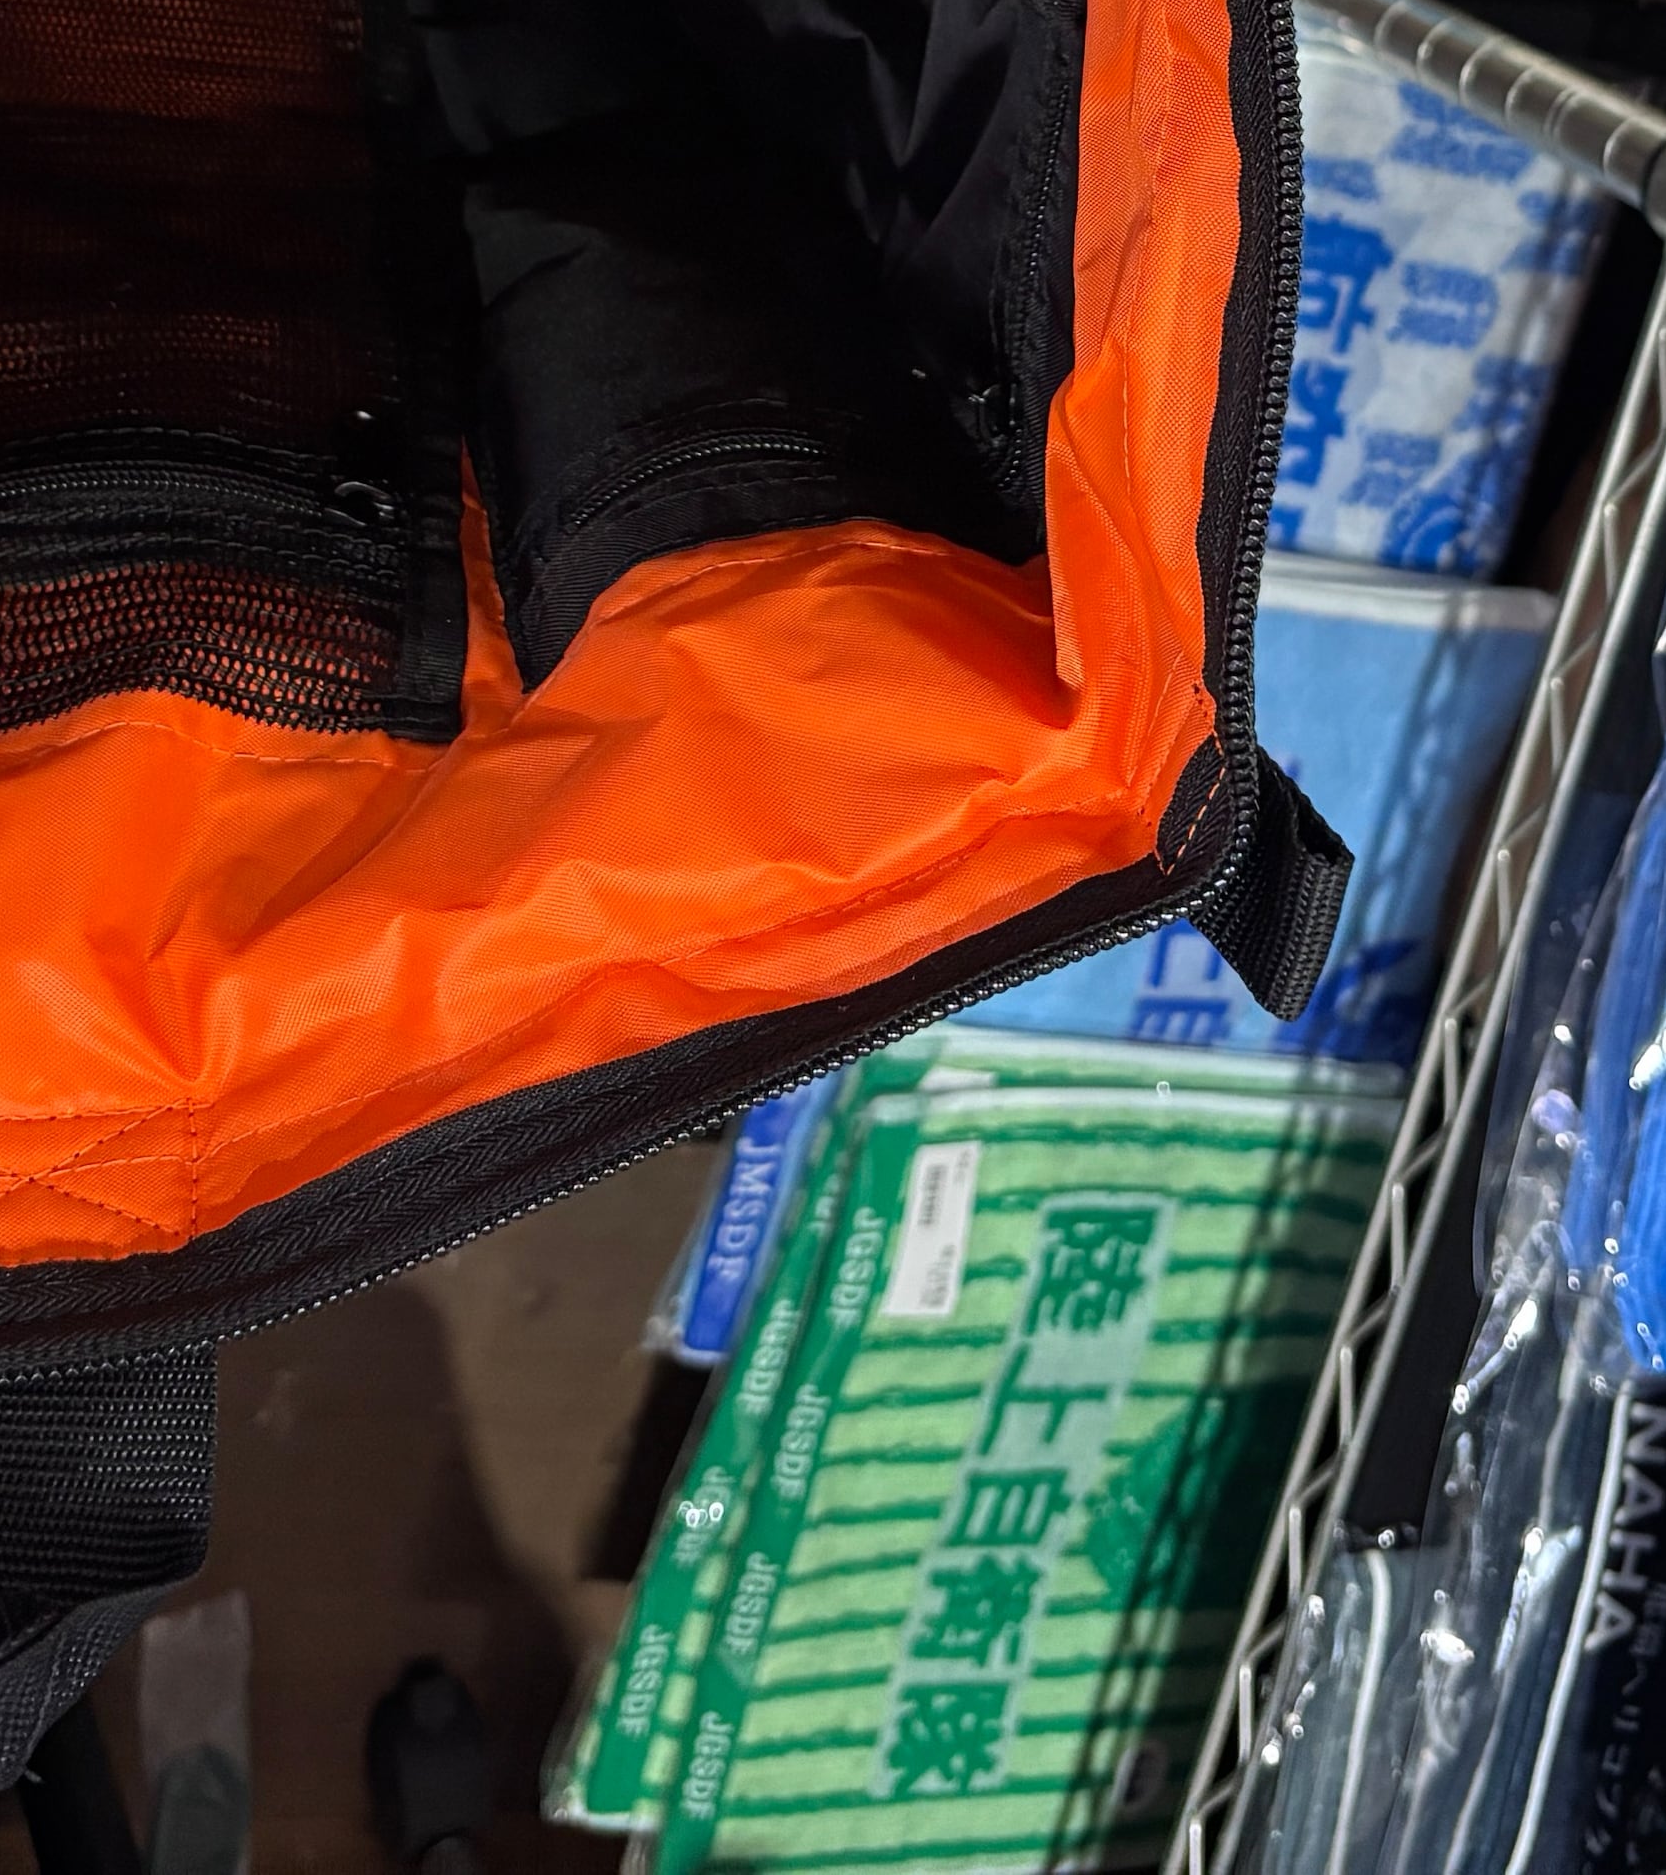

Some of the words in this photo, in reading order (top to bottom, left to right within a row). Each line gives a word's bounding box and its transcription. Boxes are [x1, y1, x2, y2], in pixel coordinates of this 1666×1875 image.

[705, 1137, 778, 1286] JMSDF
[825, 1206, 888, 1331] JGSDF
[771, 1384, 827, 1502] JGSDF
[885, 1210, 1157, 1793] 陸上自衛隊
[721, 1550, 779, 1659] JGSDF
[617, 1622, 673, 1737] JGSDF
[678, 1711, 733, 1822] JGSDF
